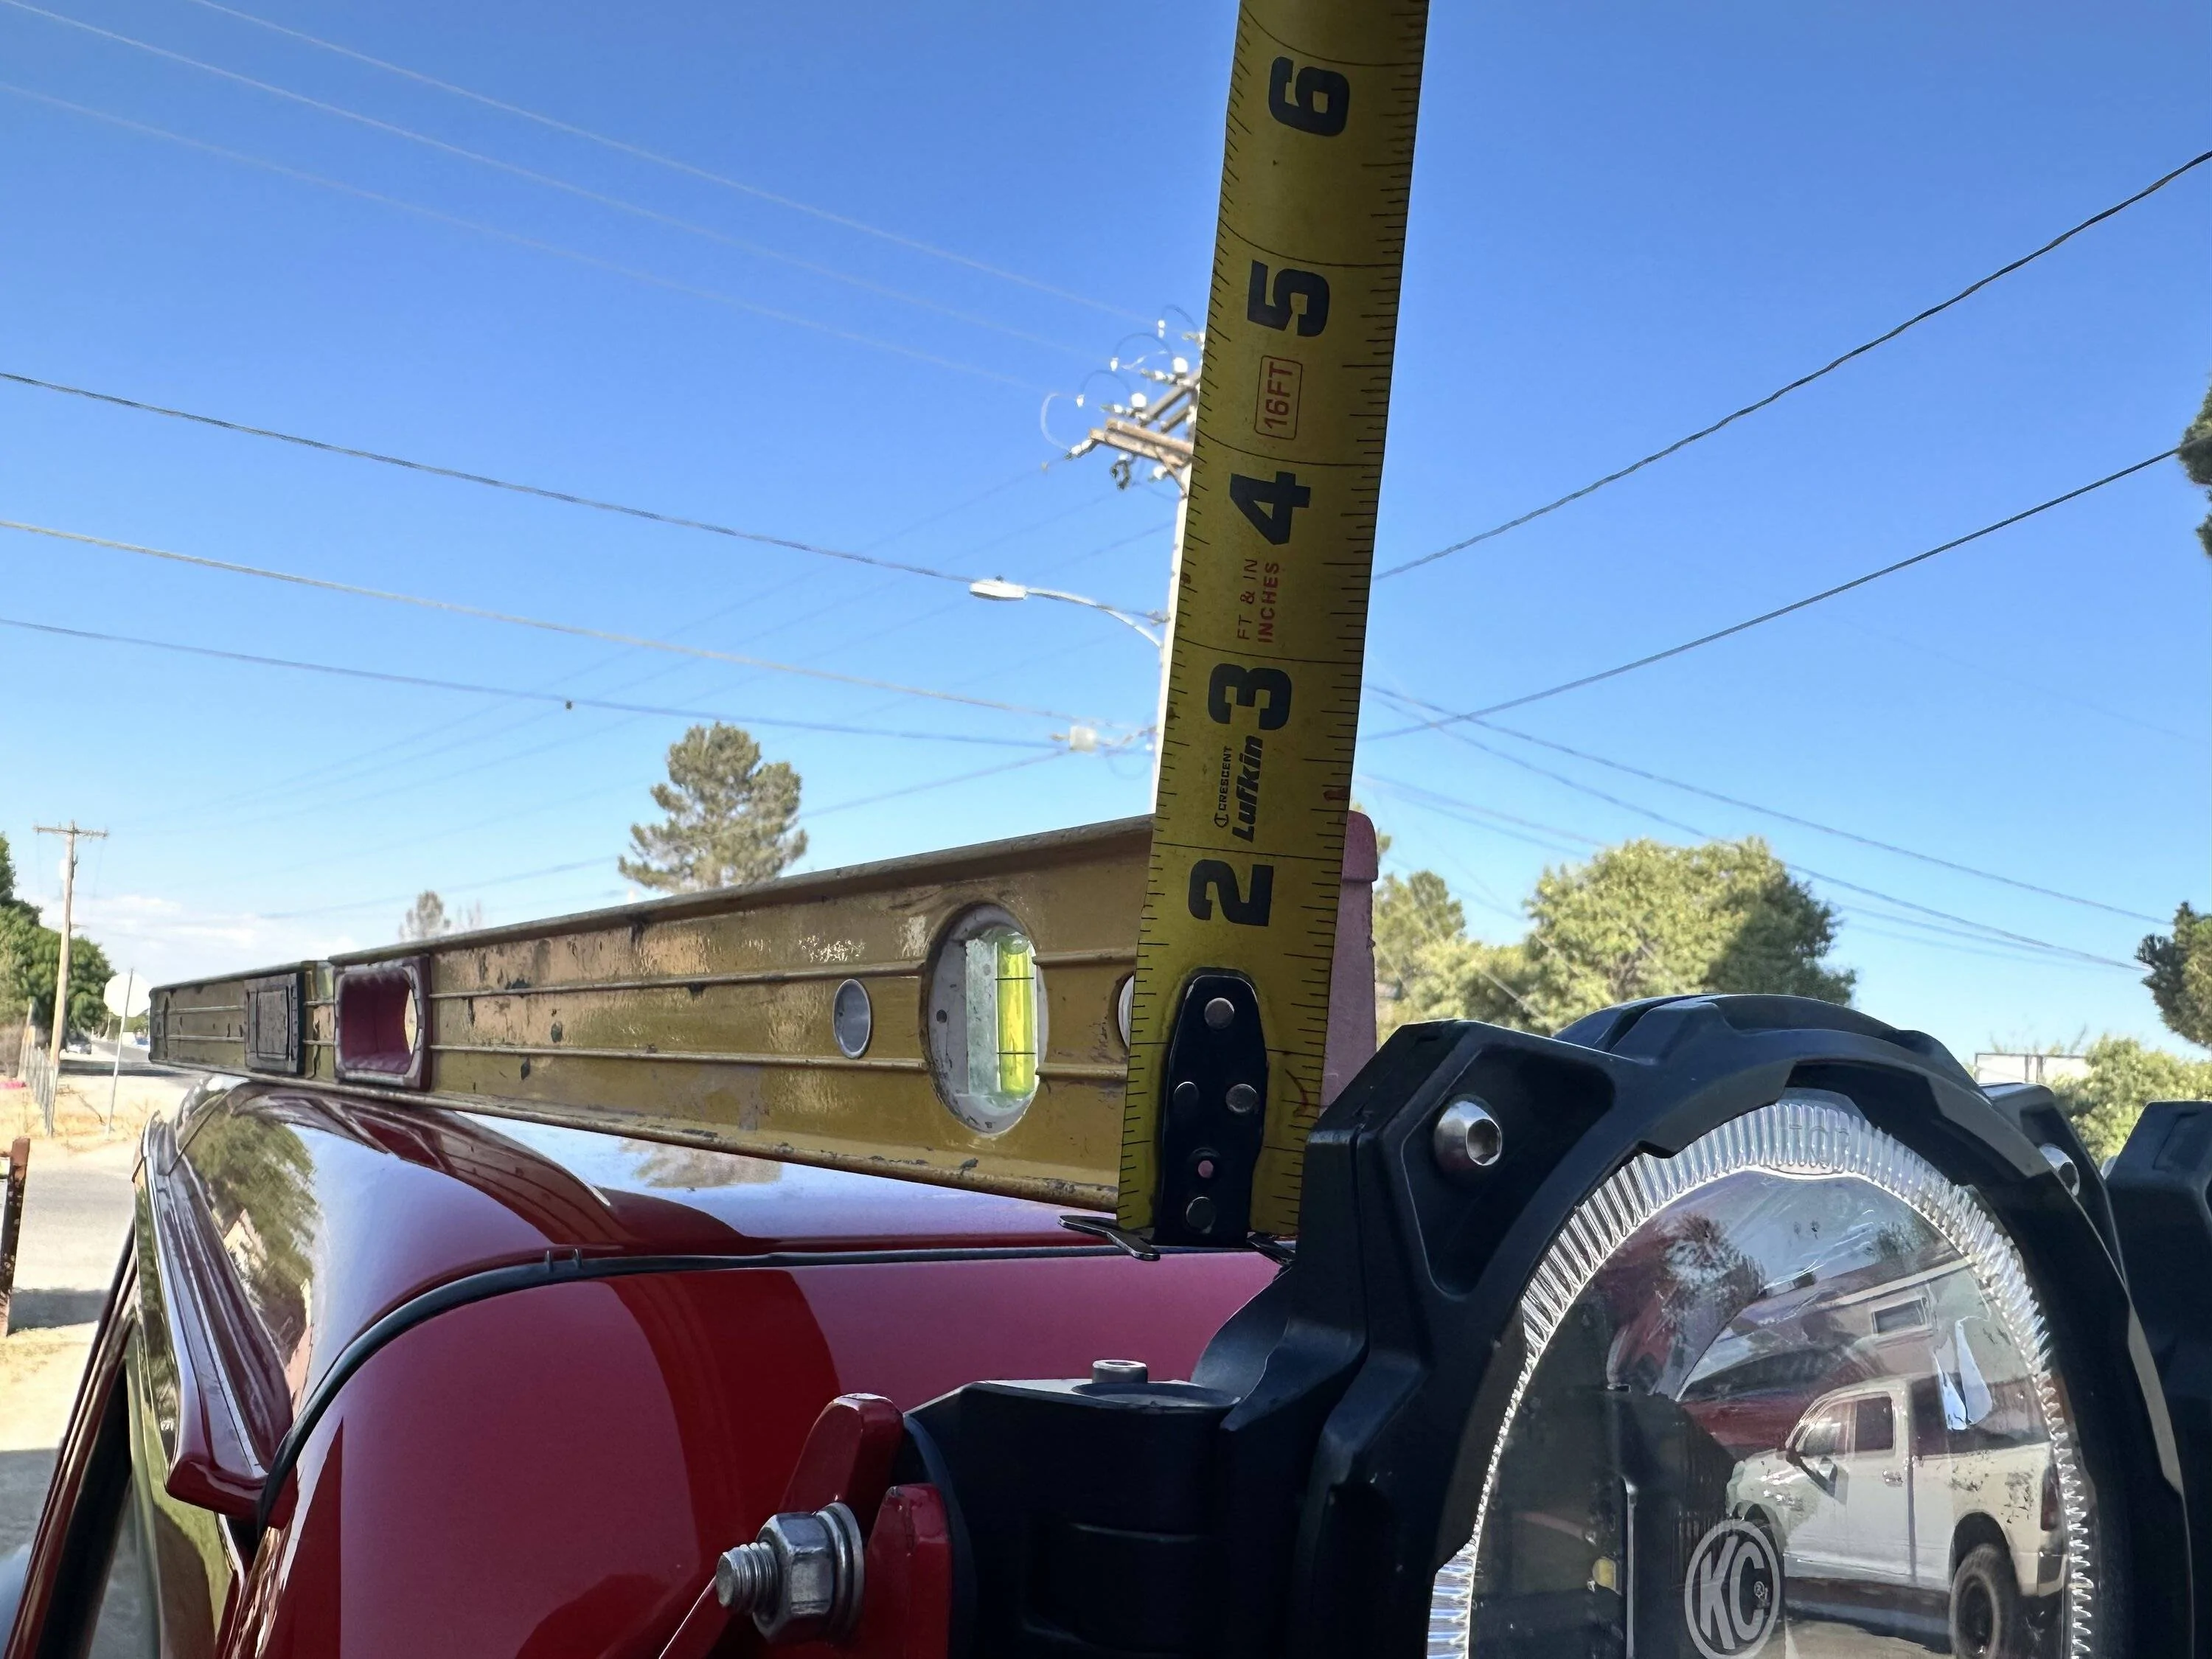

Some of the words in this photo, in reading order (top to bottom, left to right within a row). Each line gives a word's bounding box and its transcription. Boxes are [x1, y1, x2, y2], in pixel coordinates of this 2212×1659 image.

[1268, 56, 1350, 137] 6
[1247, 259, 1330, 337] 5
[1264, 361, 1294, 429] 16FT
[1229, 471, 1311, 546] 4
[1239, 591, 1255, 605] &
[1242, 559, 1258, 580] IN
[1257, 562, 1280, 643] INCHES
[1237, 614, 1253, 640] FT
[1208, 663, 1292, 731] 3
[1218, 745, 1233, 811] CRESCENT
[1232, 735, 1264, 844] Lufkin
[1188, 859, 1274, 927] 2
[1700, 1534, 1765, 1649] KC
